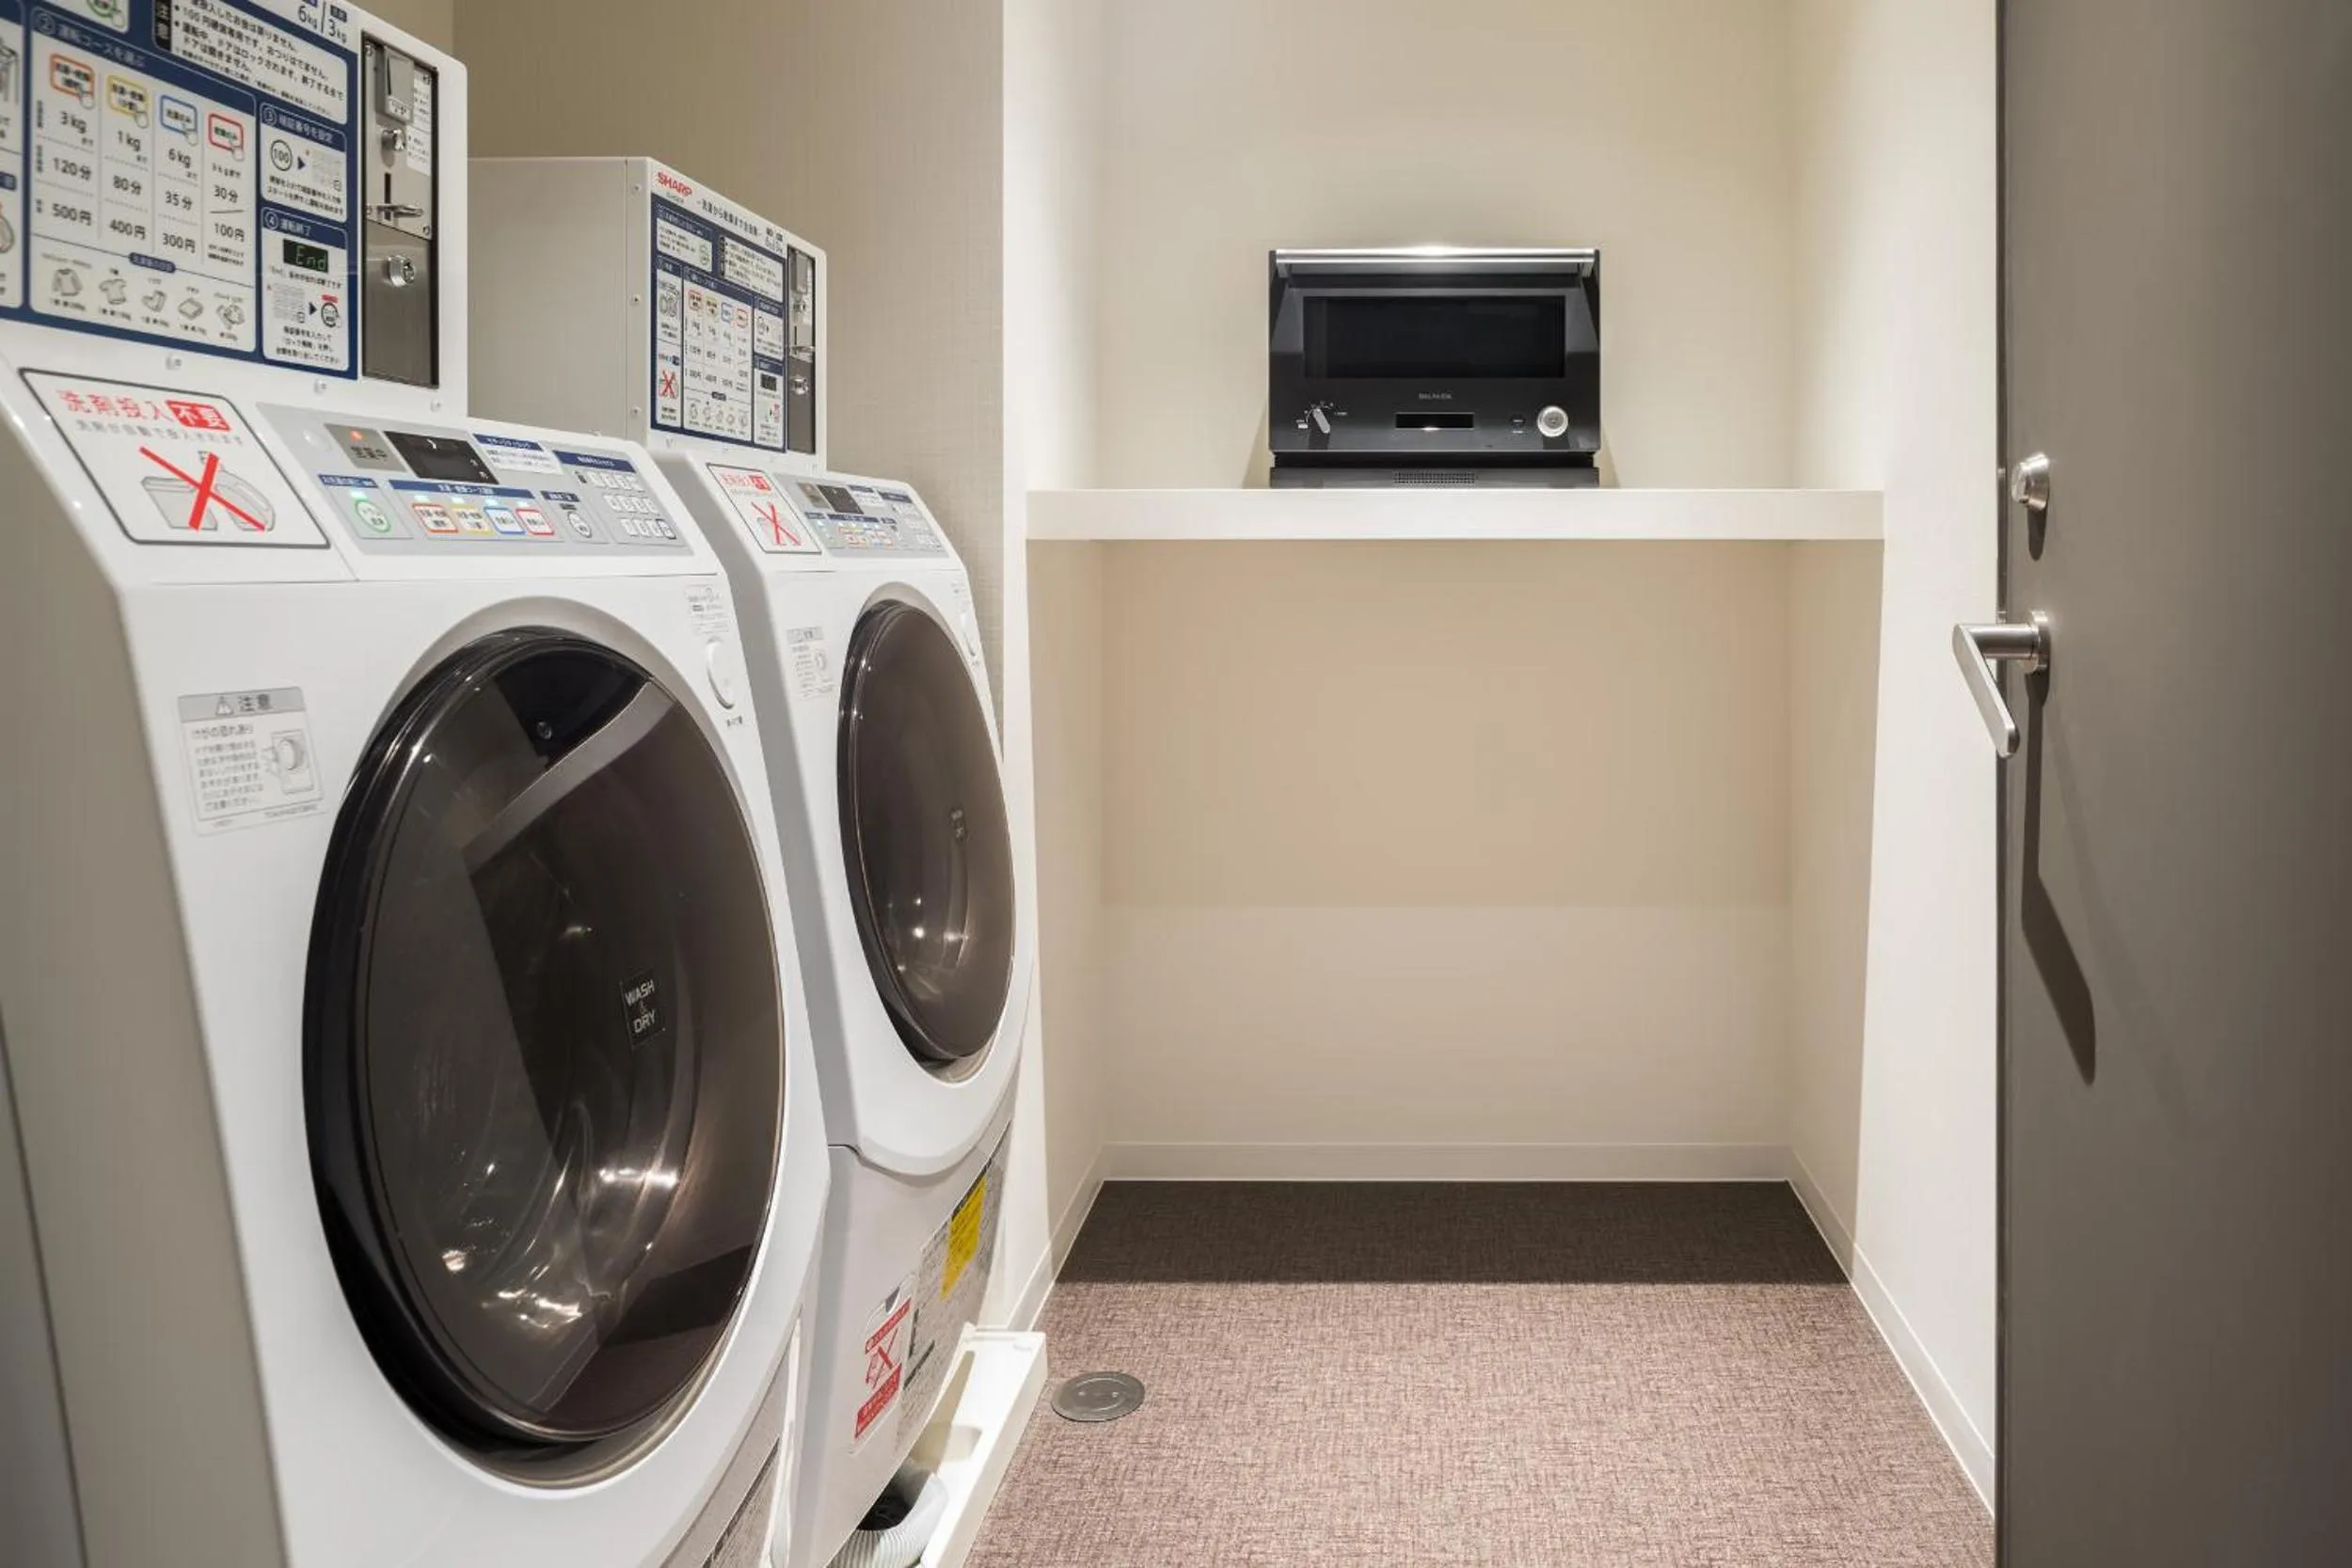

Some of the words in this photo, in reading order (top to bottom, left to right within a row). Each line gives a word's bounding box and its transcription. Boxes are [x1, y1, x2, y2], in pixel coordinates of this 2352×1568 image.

[657, 171, 692, 197] SHARP
[294, 245, 326, 271] End
[625, 979, 655, 1006] WASH
[633, 1009, 656, 1034] DRY
